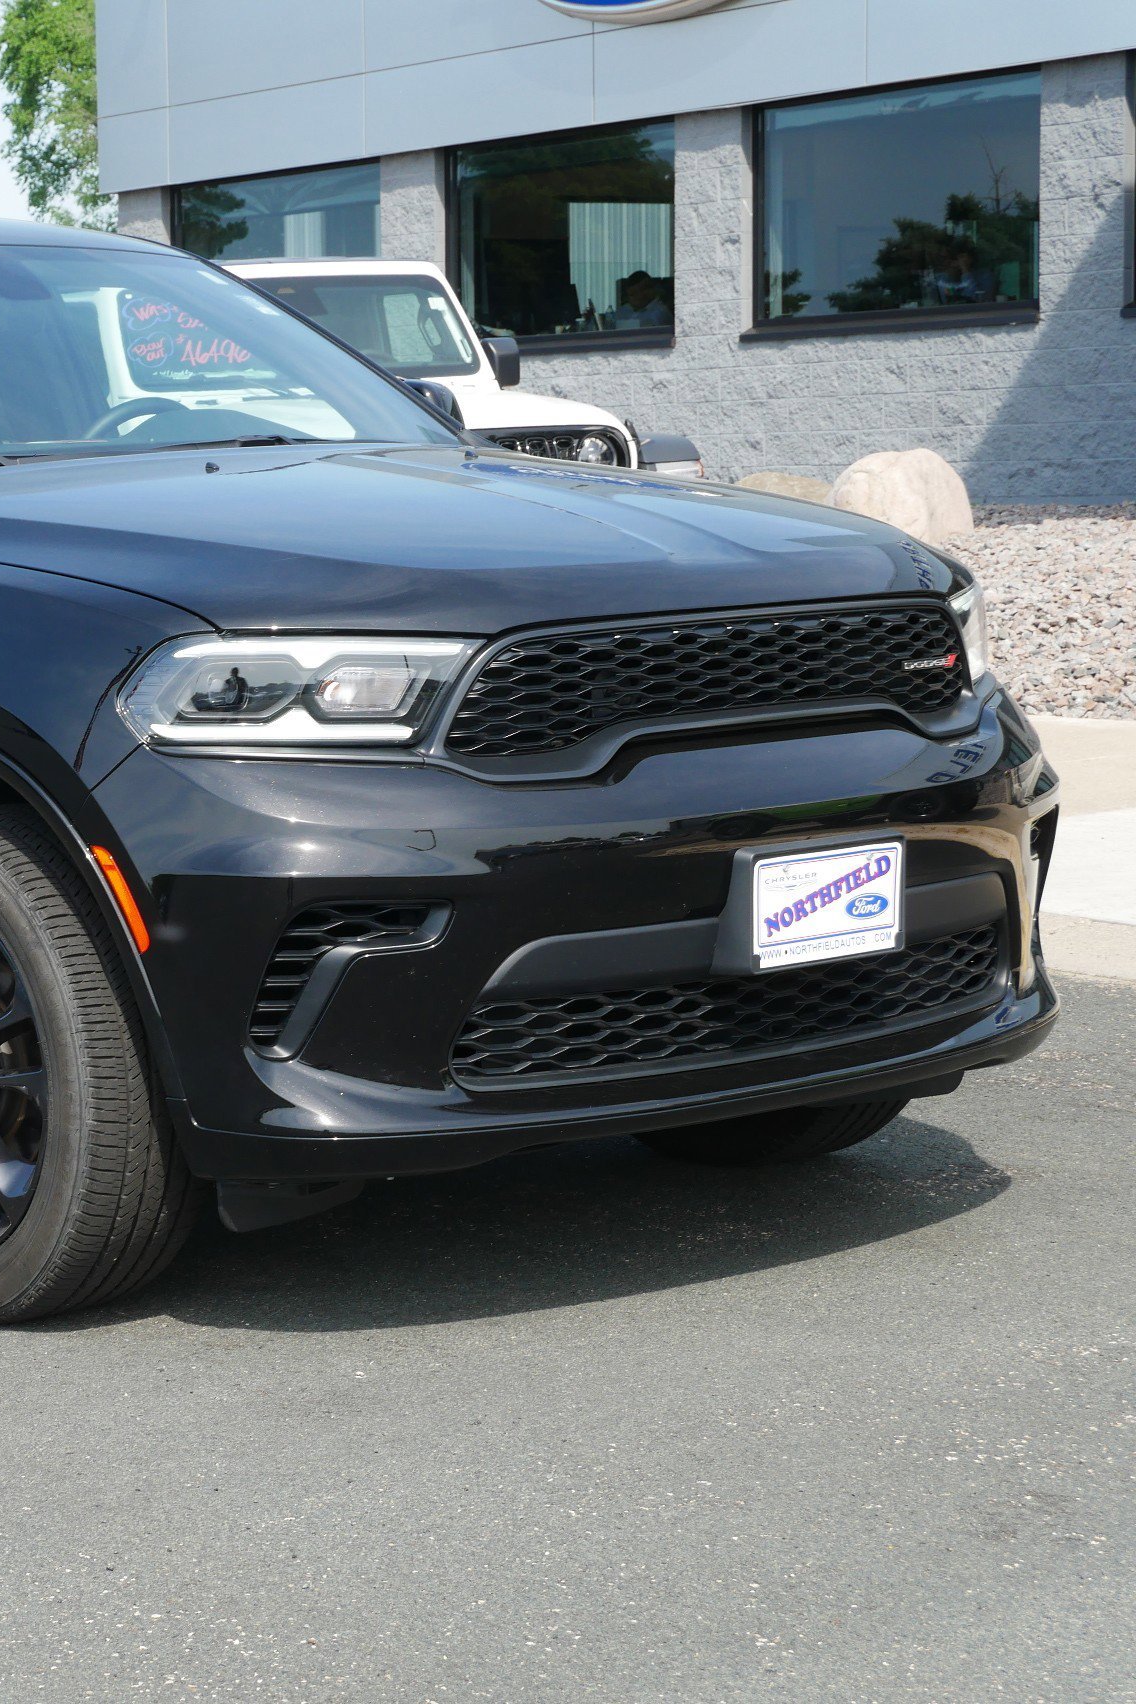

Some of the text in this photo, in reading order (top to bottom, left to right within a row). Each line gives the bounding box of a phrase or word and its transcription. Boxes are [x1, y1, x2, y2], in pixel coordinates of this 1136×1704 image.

[764, 872, 817, 885] CHRYSLER
[764, 855, 891, 937] NORTHFIELD
[852, 896, 881, 915] Ford
